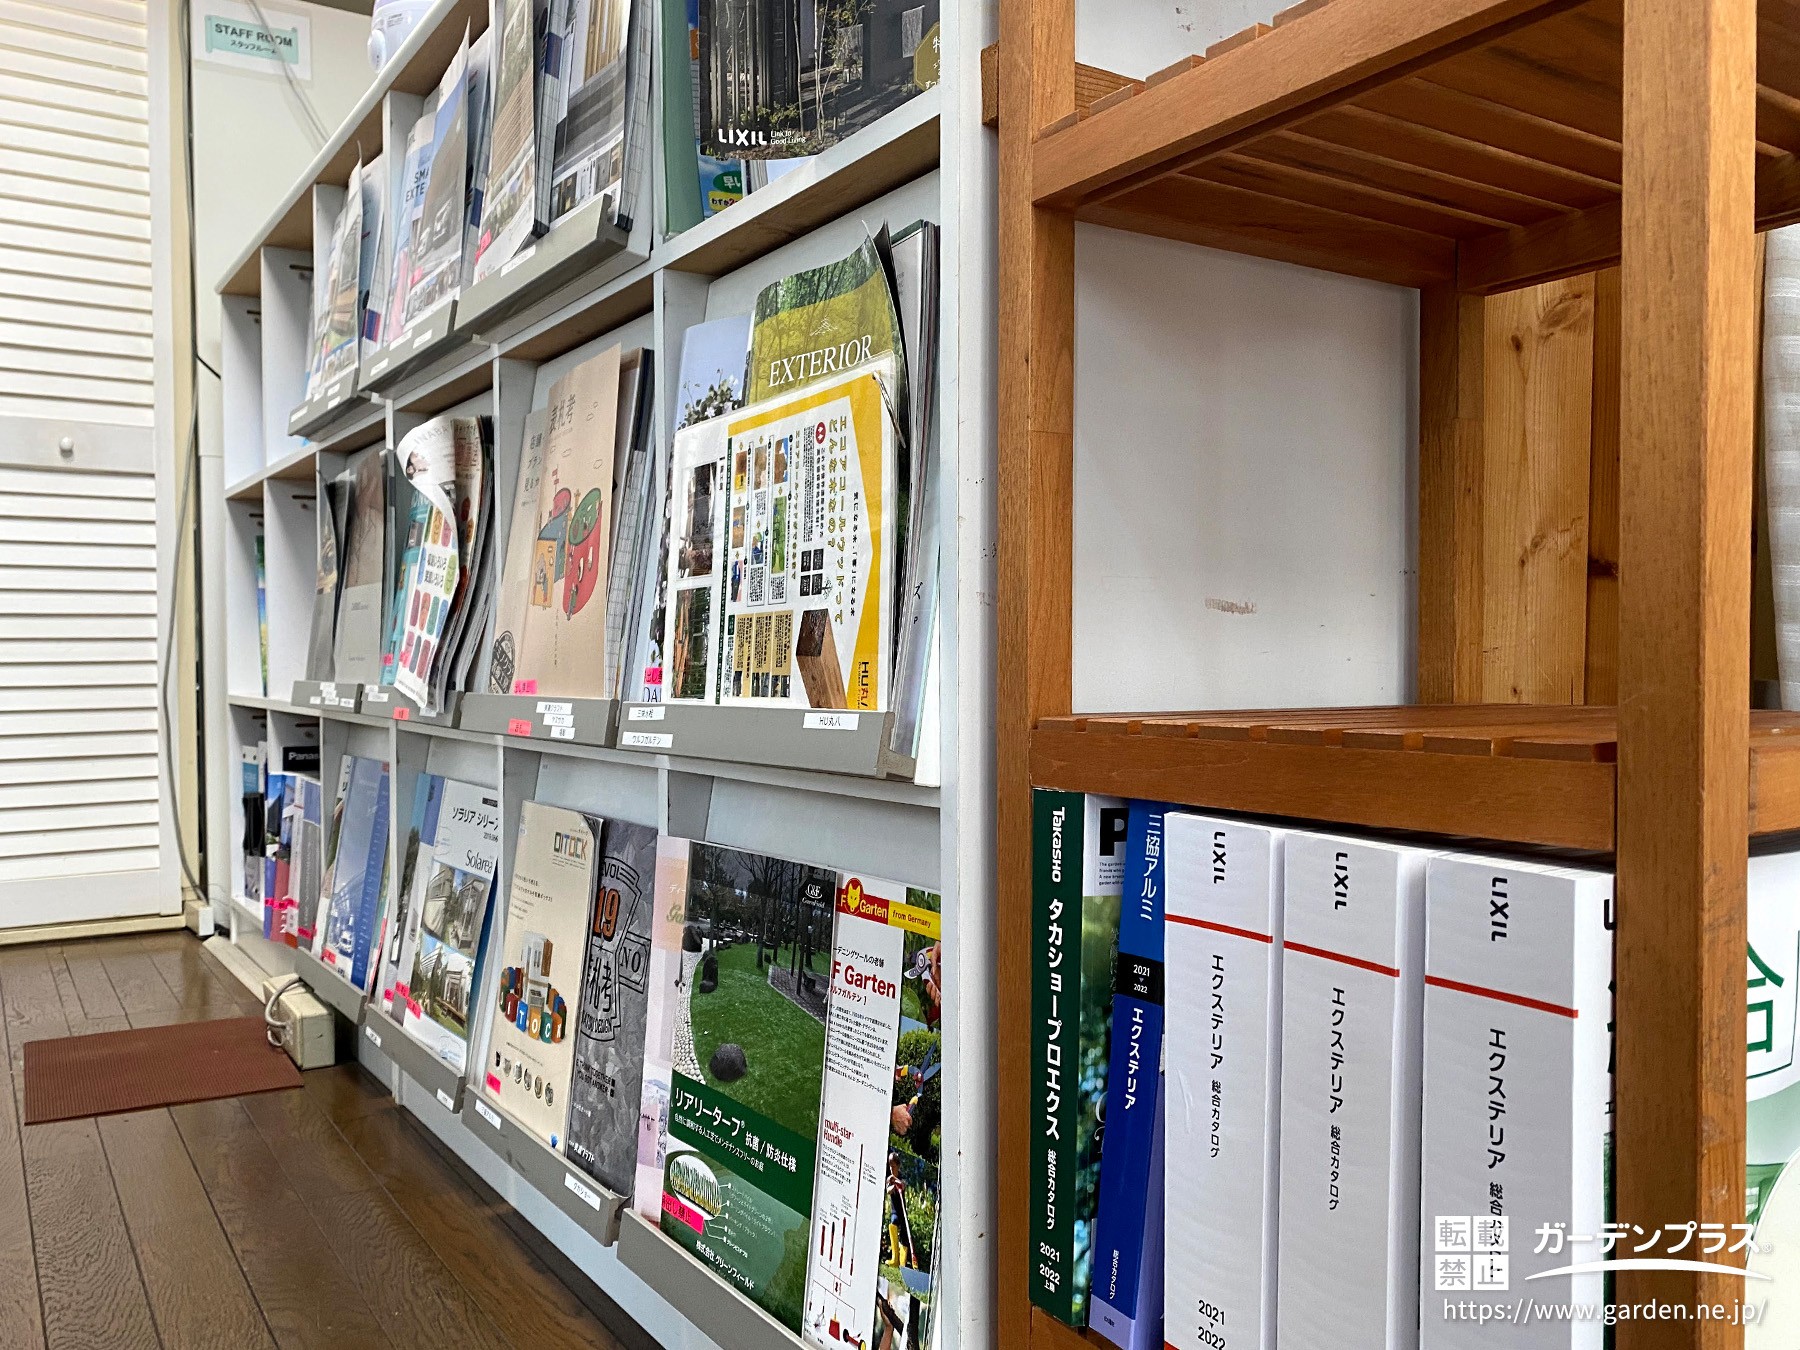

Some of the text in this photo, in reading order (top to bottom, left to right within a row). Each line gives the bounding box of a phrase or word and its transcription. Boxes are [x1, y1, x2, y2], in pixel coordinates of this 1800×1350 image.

[214, 22, 254, 41] STAFF
[718, 128, 768, 147] LIXIL
[770, 130, 784, 138] Link
[788, 136, 806, 144] Living
[767, 334, 874, 389] EXTERIOR
[835, 415, 848, 625] エコアコールウッドって
[817, 715, 842, 728] HU丸八
[452, 806, 477, 824] ソラリア
[465, 849, 493, 874] Solarea
[1107, 861, 1123, 869] garden
[1138, 812, 1164, 923] 三協アルミ
[1212, 831, 1227, 885] LIXIL
[1333, 851, 1349, 911] LIXIL
[593, 886, 621, 943] 19
[859, 899, 888, 920] Garten
[892, 909, 932, 929] from Germany
[1489, 876, 1511, 942] LIXIL
[620, 946, 642, 974] NO
[1133, 963, 1151, 978] 2021
[831, 960, 897, 1000] F Garten
[1133, 983, 1149, 995] 2022
[1043, 897, 1066, 1142] タカショープロエクス
[1210, 954, 1225, 1070] エクステリア
[1125, 1007, 1145, 1111] エクステリア
[1329, 987, 1346, 1115] エクステリア
[1486, 1027, 1508, 1170] エクステリア
[1210, 1079, 1222, 1159] 総合カタログ
[1328, 1124, 1342, 1211] 総合カタログ
[1045, 1148, 1058, 1231] 総合カタログ
[1039, 1241, 1061, 1263] 2021
[714, 1254, 756, 1291] グリーンフィールド
[1039, 1263, 1061, 1286] 2022
[1109, 1249, 1120, 1300] 総合カタログ
[1198, 1299, 1226, 1326] 2021
[1197, 1326, 1226, 1350] 2022
